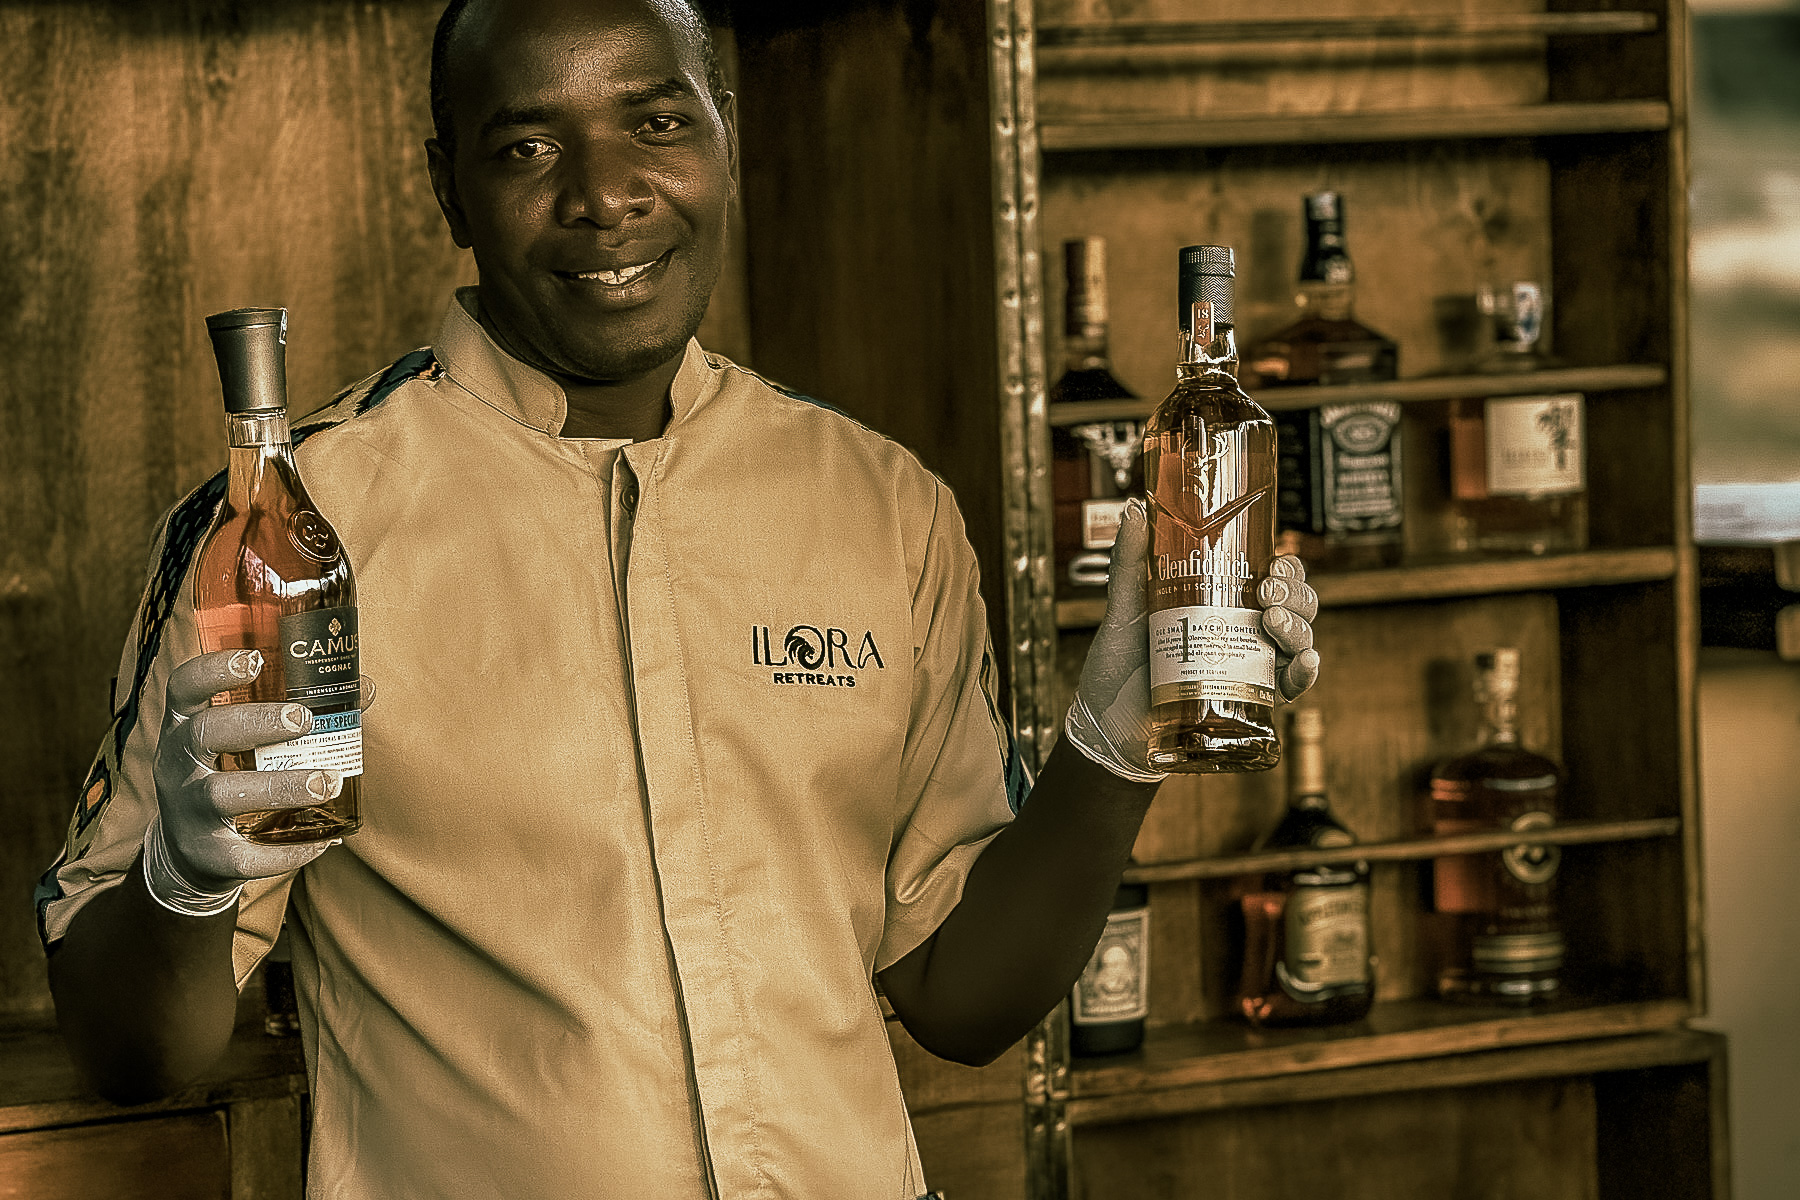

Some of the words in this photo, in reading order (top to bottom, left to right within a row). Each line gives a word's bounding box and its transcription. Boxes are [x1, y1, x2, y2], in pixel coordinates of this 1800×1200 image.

[1197, 308, 1209, 319] 18
[1167, 626, 1184, 634] SMAL
[752, 625, 885, 670] ILORA
[318, 662, 352, 674] COGNAC
[773, 672, 856, 687] RETREATS
[314, 716, 332, 731] ERY
